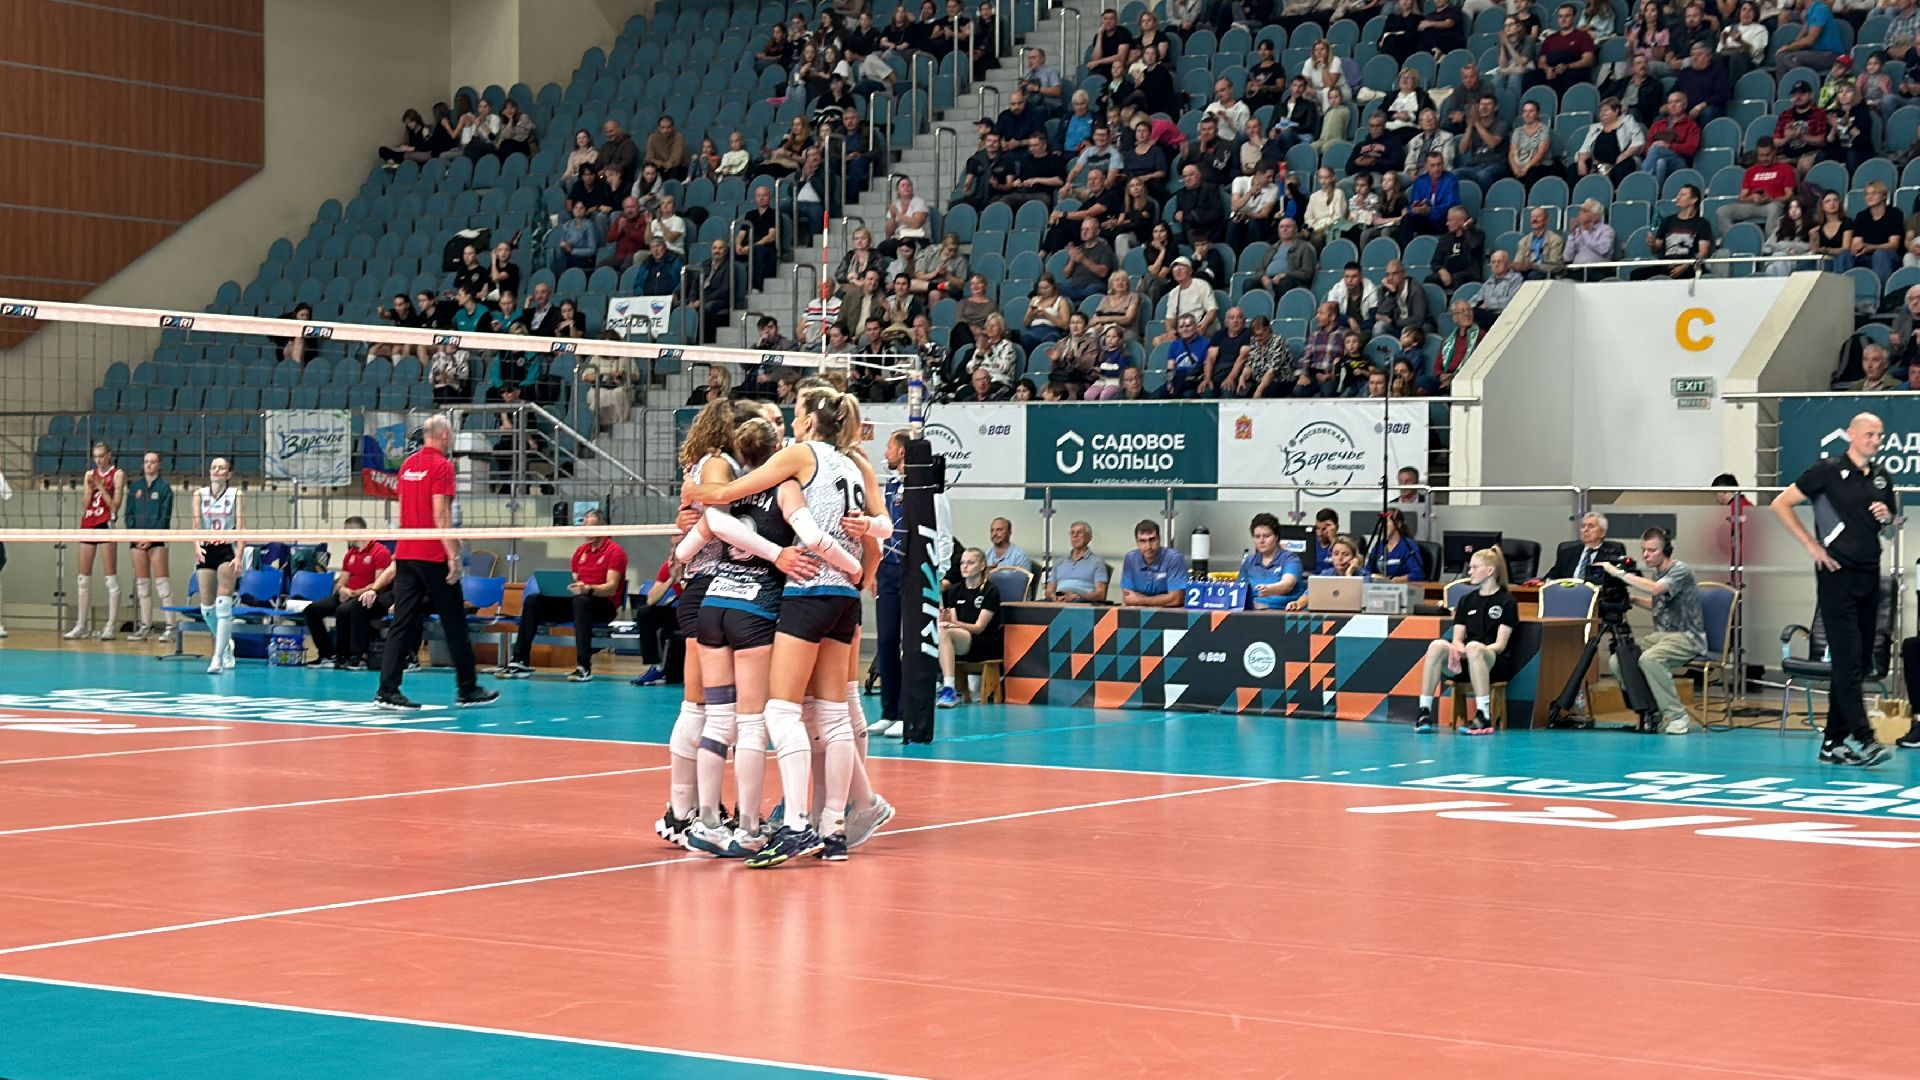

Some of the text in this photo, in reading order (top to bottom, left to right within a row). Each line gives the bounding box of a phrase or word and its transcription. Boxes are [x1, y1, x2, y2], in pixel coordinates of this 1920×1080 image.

[2, 304, 35, 317] PARI
[162, 317, 192, 328] PARI
[304, 326, 332, 337] PARI
[434, 336, 461, 346] PARI
[553, 342, 576, 352] PARI
[660, 349, 683, 359] PARI
[1677, 380, 1705, 391] EXIT
[1091, 433, 1186, 452] САДОВОЕ
[1092, 453, 1174, 472] КОЛЬЦО
[1187, 588, 1200, 606] 2
[1229, 589, 1239, 607] 1
